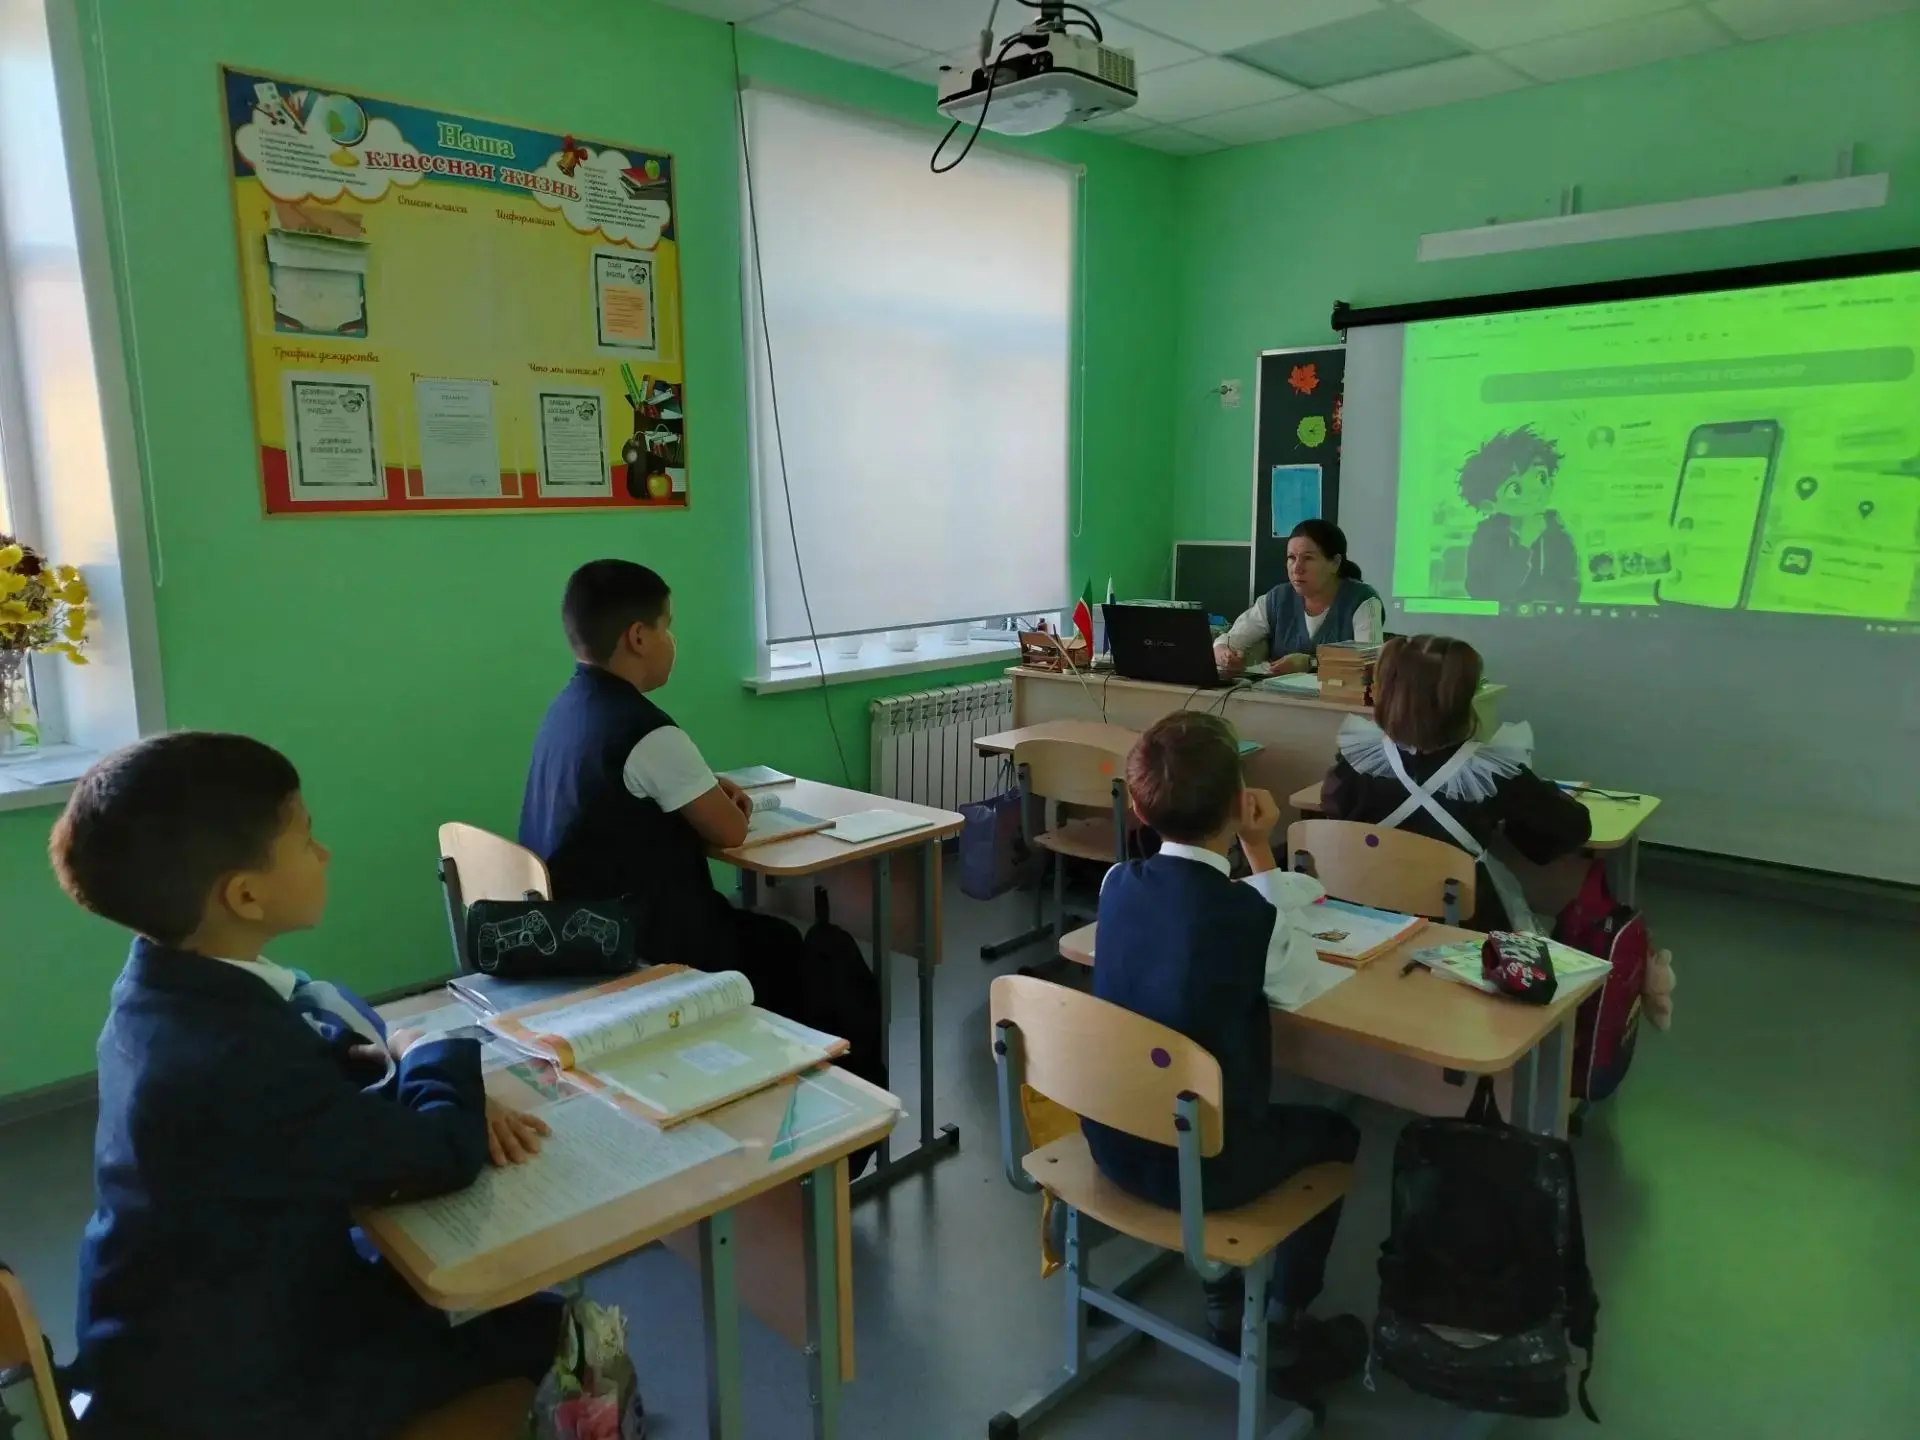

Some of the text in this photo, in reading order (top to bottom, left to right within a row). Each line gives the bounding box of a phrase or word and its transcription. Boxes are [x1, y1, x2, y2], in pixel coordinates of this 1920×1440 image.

[438, 121, 515, 158] Наша
[365, 151, 495, 182] классная
[501, 167, 582, 202] жизнь
[397, 195, 468, 214] Список класса
[495, 209, 555, 228] Информация
[272, 346, 380, 365] График дежурства
[528, 362, 548, 373] Что
[549, 366, 564, 374] мы
